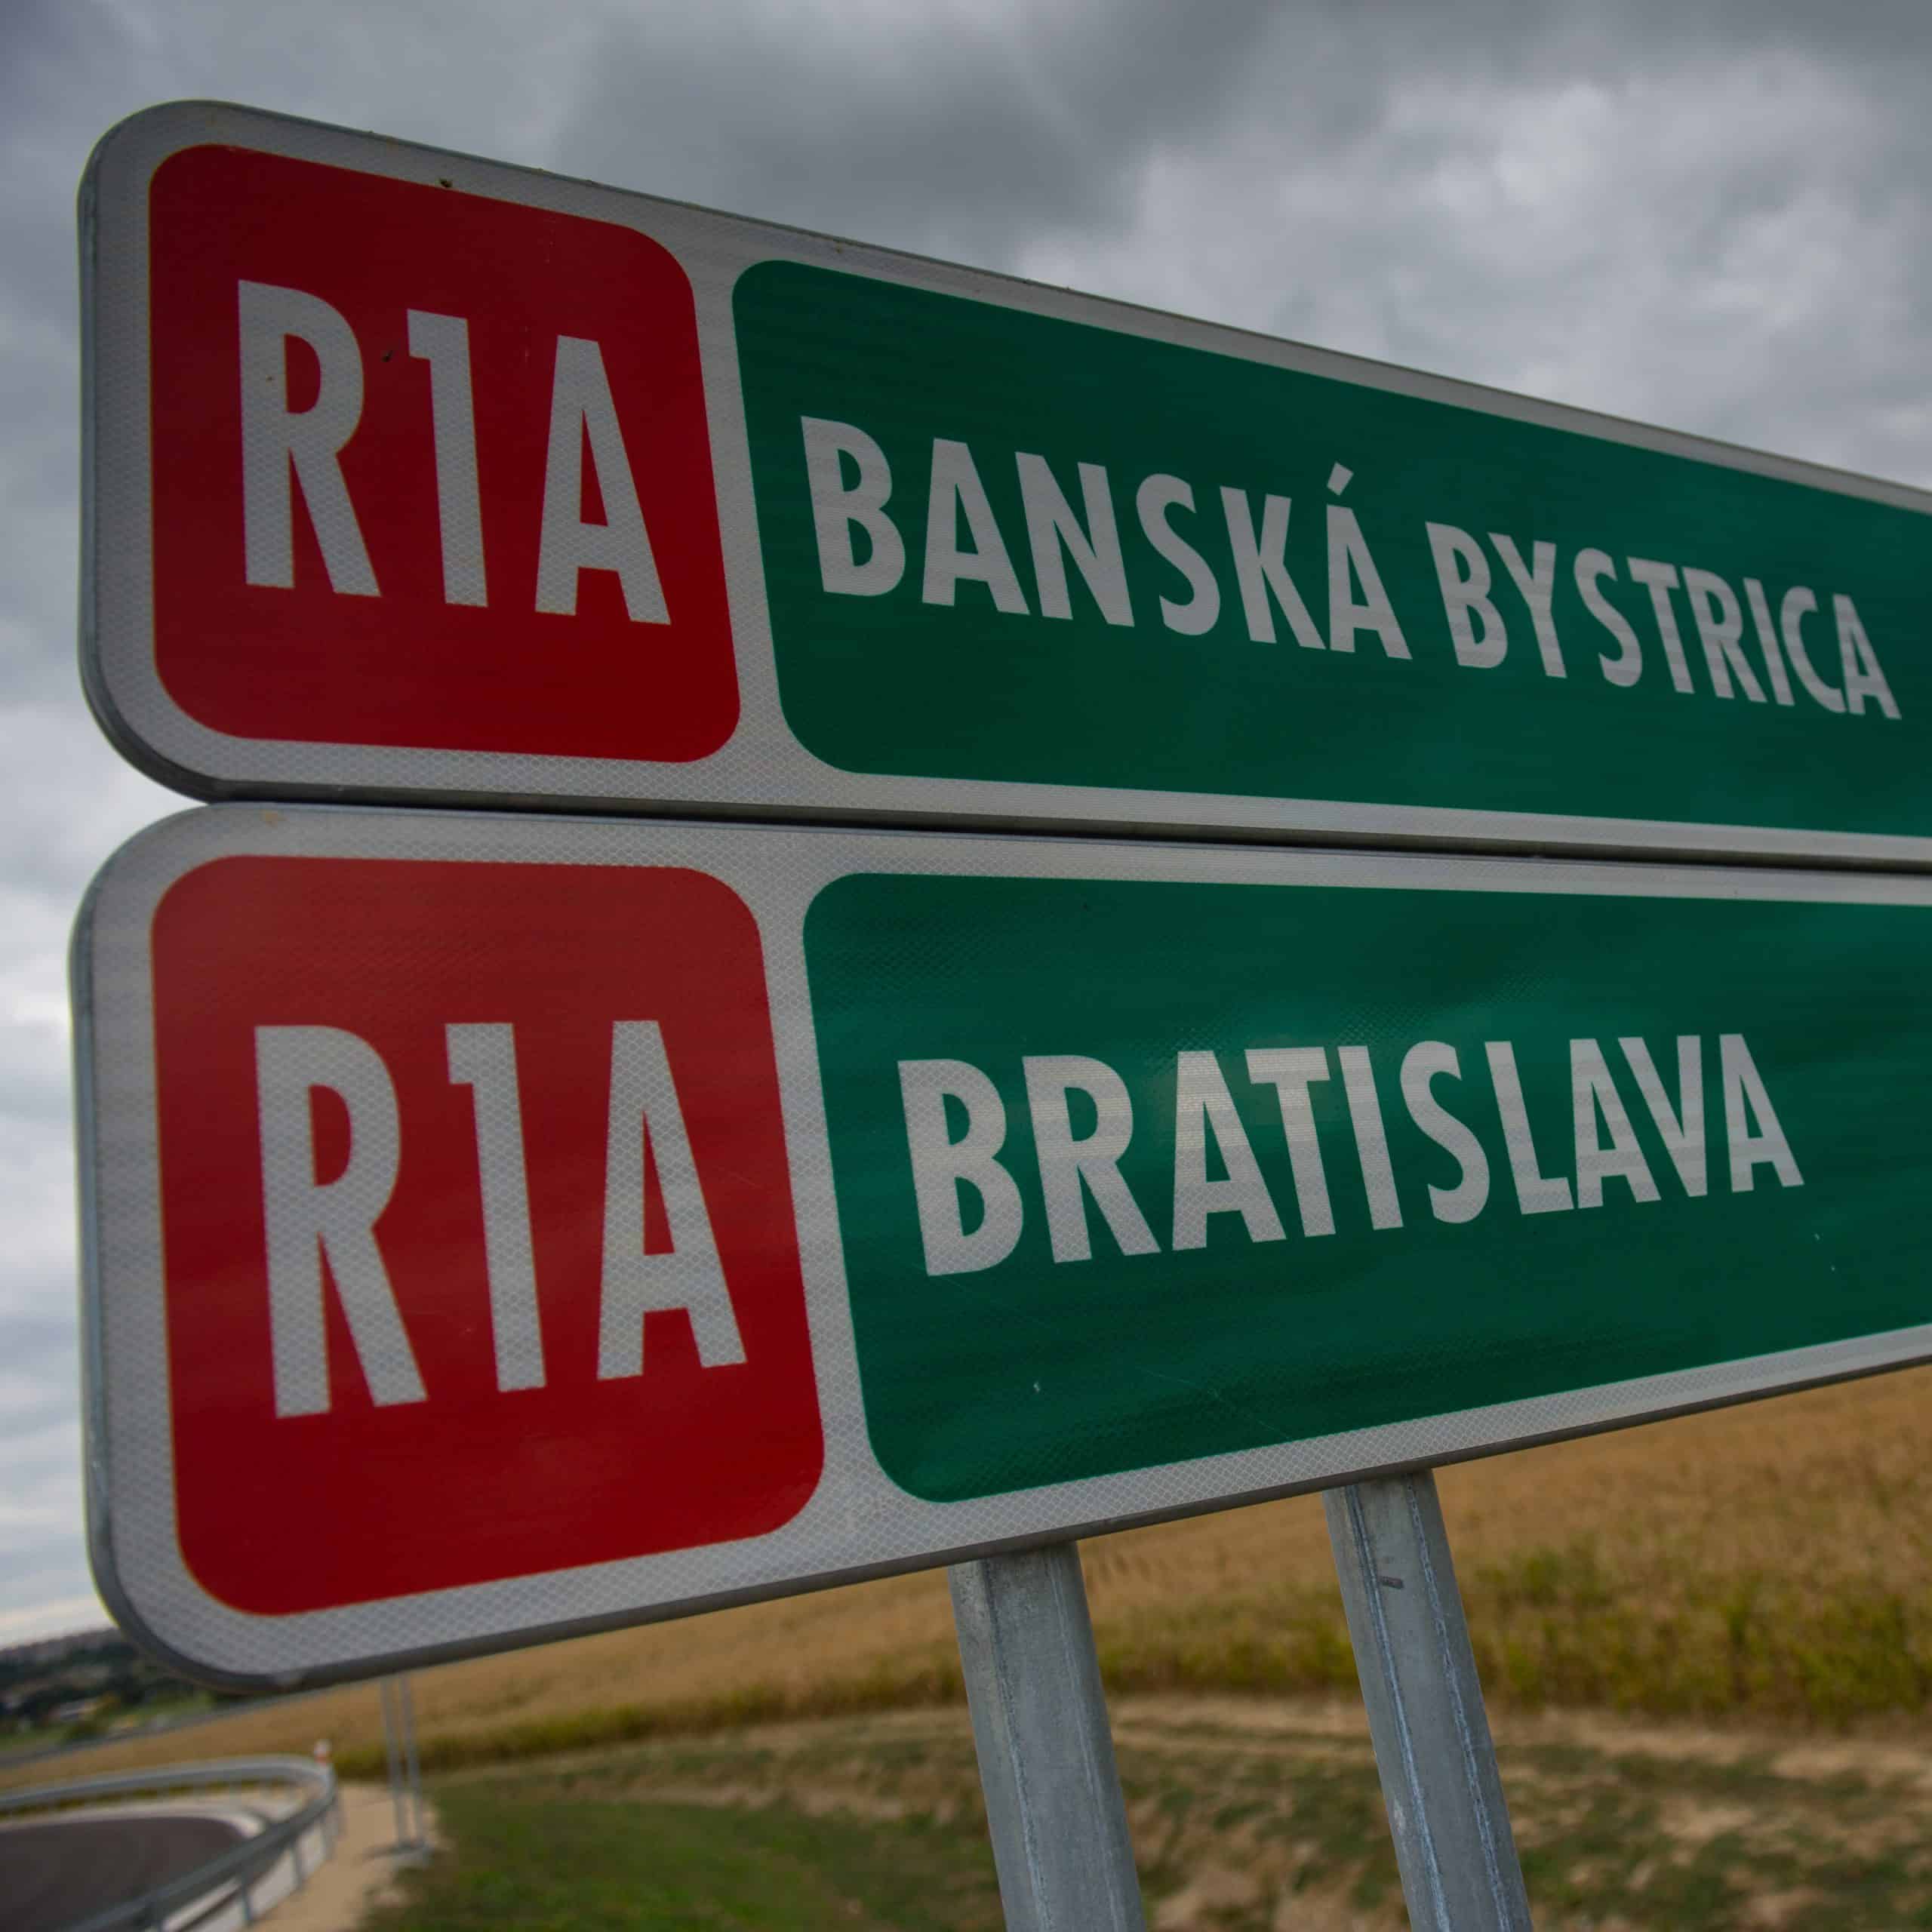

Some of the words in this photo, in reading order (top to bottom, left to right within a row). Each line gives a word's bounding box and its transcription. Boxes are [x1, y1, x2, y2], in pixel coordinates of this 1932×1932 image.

[238, 281, 670, 625] R1A
[801, 416, 1411, 660] BANSKÁ
[1425, 521, 1901, 719] BYSTRICA
[254, 1021, 746, 1417] R1A
[898, 1034, 1804, 1277] BRATISLAVA
